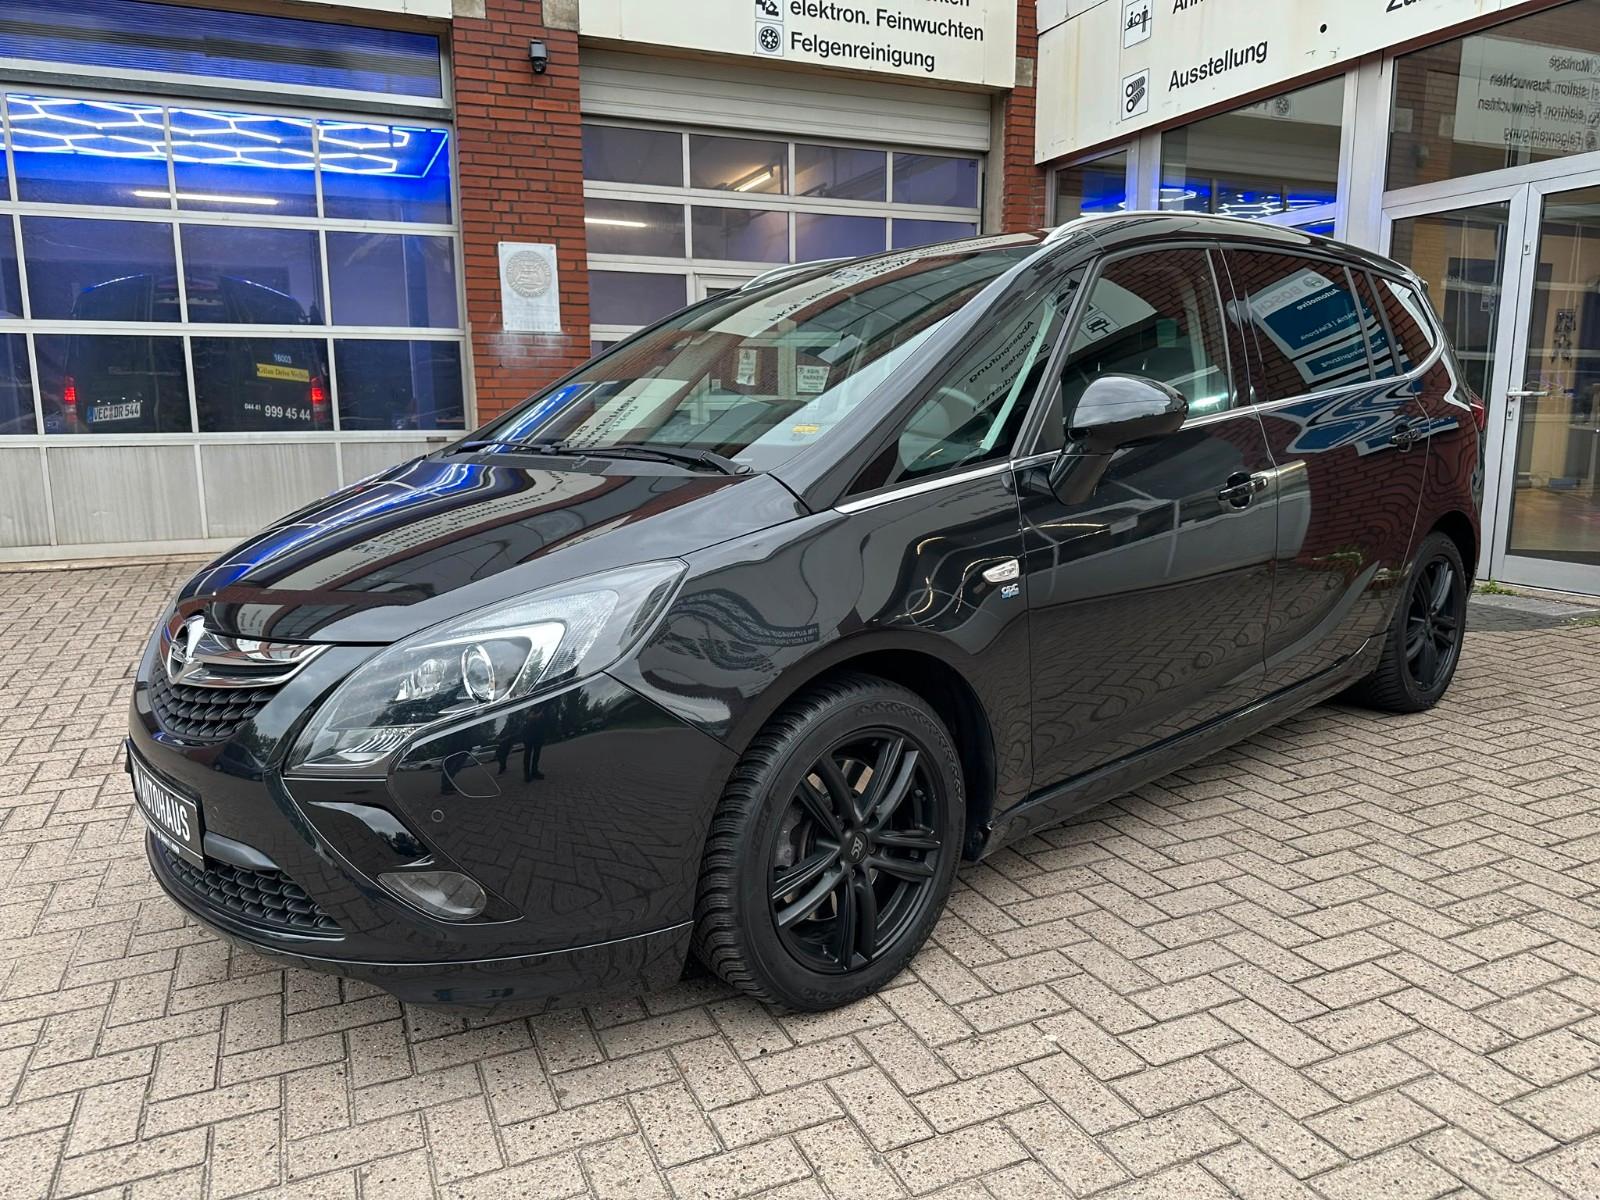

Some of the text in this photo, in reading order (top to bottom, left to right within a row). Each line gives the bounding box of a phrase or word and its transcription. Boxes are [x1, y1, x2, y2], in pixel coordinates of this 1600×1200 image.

[790, 0, 984, 41] elektron. Feinwuchten
[791, 31, 935, 72] Felgenreinigung
[1168, 40, 1268, 92] Ausstellung
[113, 405, 124, 418] DR
[124, 403, 139, 417] 544
[264, 404, 284, 418] 999
[285, 407, 298, 420] 45
[299, 408, 311, 421] 44
